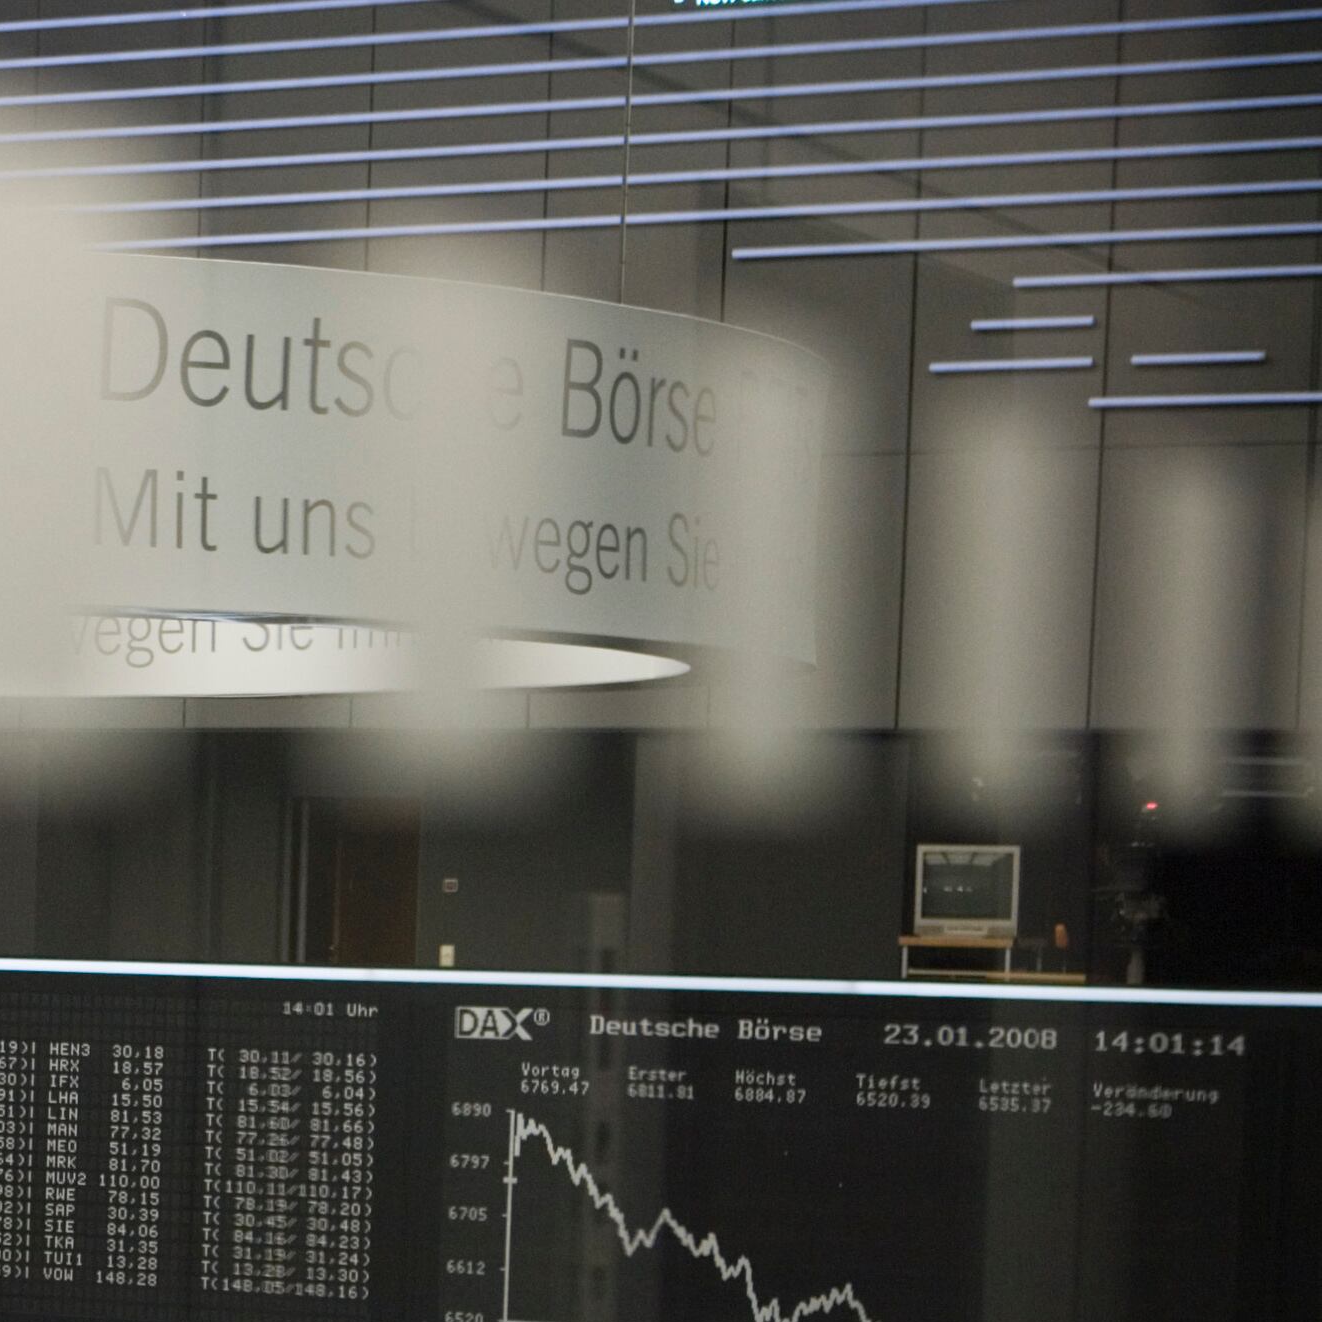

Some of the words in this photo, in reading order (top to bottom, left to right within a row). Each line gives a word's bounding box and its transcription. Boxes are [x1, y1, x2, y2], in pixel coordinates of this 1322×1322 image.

[99, 298, 524, 431] Deutsce
[561, 338, 716, 456] Börse
[93, 466, 219, 551] Mit
[253, 492, 376, 559] uns
[403, 510, 649, 596] wegen
[666, 511, 721, 590] Sie
[284, 1002, 333, 1015] 14:01
[347, 1004, 377, 1016] Uhr
[589, 1014, 720, 1039] Deutsche
[737, 1018, 822, 1043] Börse
[885, 1024, 1057, 1050] 23.01.2008
[1095, 1031, 1246, 1057] 14:01:14
[50, 1043, 90, 1056] HEN3
[50, 1059, 79, 1071] HRX
[51, 1075, 78, 1087] IFX
[521, 1063, 580, 1079] Vortag
[628, 1066, 686, 1082] Erster
[735, 1068, 796, 1086] Höchst
[856, 1073, 920, 1091] Tiefst
[979, 1078, 1052, 1096] Letzter
[1093, 1082, 1219, 1104] Veränderung
[521, 1081, 590, 1096] 6769.47
[49, 1092, 78, 1103] LHA
[48, 1107, 78, 1120] LIN
[452, 1103, 492, 1117] 6890
[48, 1124, 77, 1136] MAN
[47, 1140, 76, 1152] MEO
[47, 1156, 76, 1168] MRK
[450, 1155, 490, 1169] 6797
[46, 1172, 86, 1185] MUV2
[46, 1188, 75, 1200] RWE
[46, 1204, 74, 1216] SAP
[448, 1207, 488, 1221] 6705
[45, 1220, 74, 1233] SIE
[45, 1235, 74, 1248] TKA
[45, 1252, 81, 1265] TUI1
[44, 1268, 73, 1280] VOW
[447, 1260, 485, 1275] 6612
